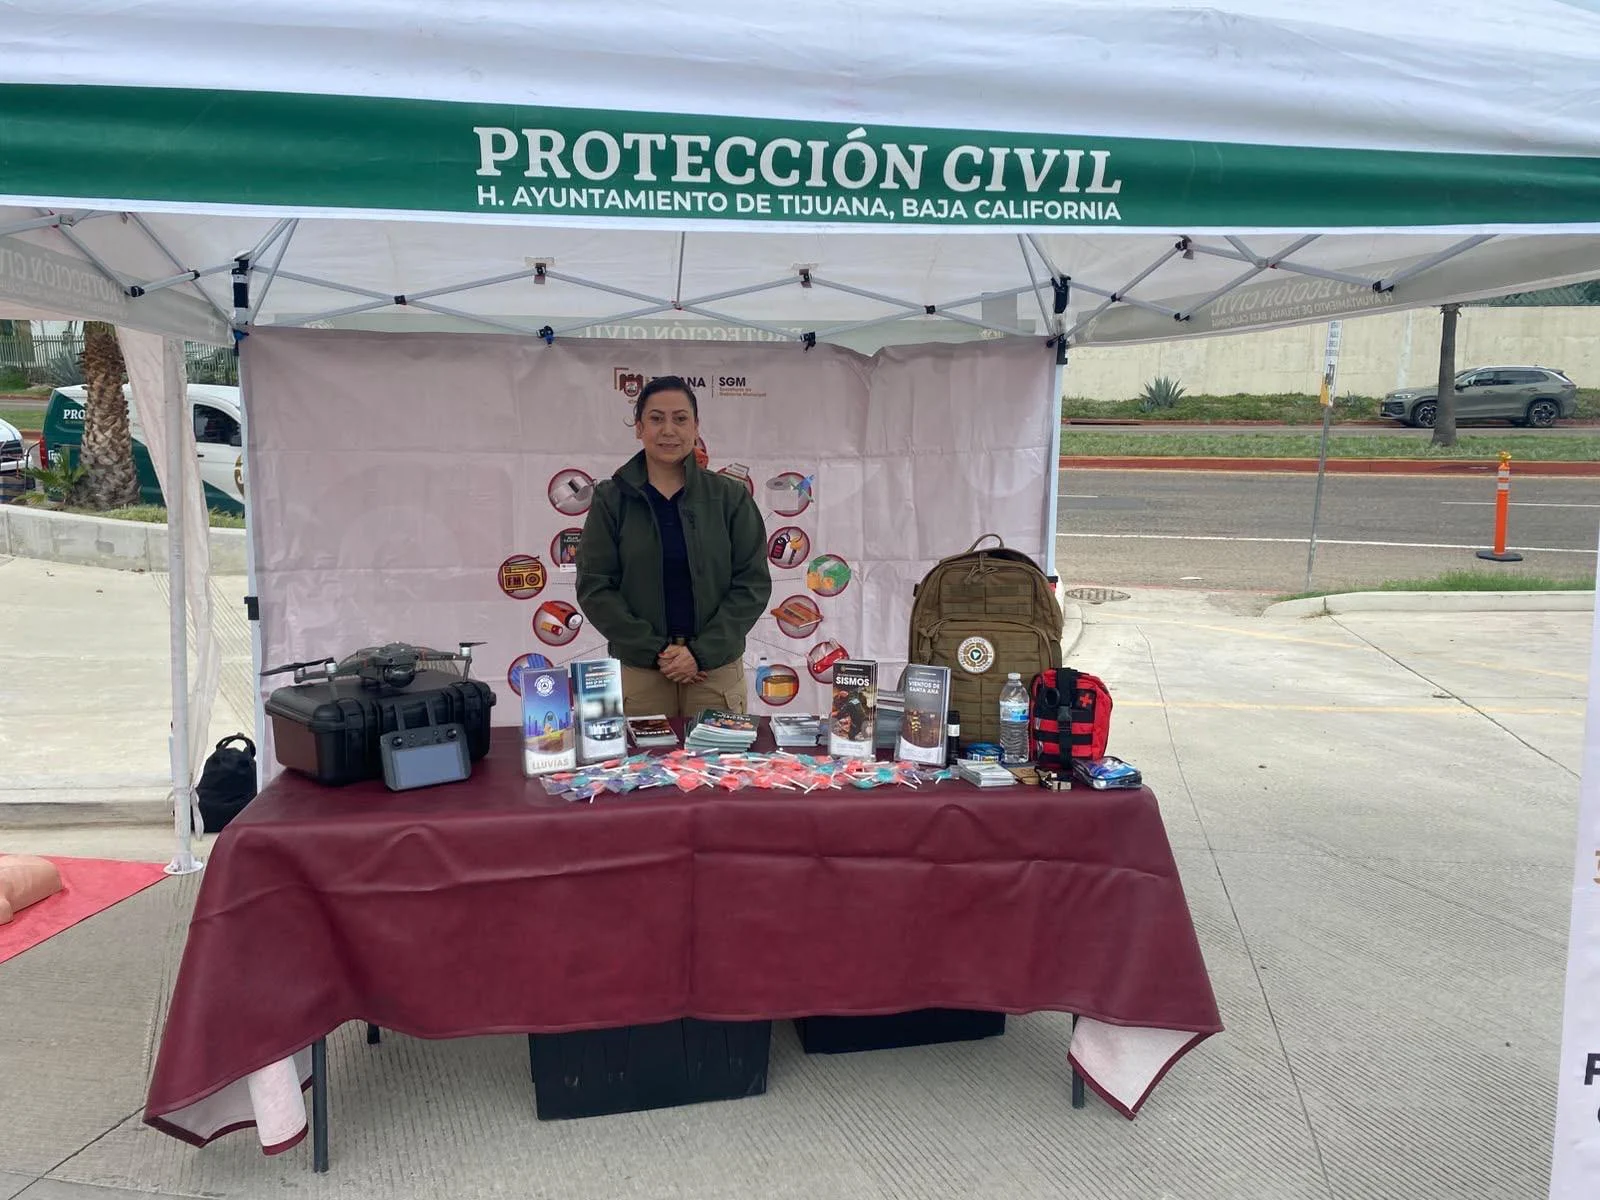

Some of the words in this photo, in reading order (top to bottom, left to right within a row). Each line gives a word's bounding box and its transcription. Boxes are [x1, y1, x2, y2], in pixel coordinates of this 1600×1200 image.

[473, 126, 929, 190] PROTECCIÓN
[943, 144, 1122, 194] CIVIL
[477, 185, 505, 206] H.
[511, 186, 728, 213] AYUNTAMIENTO
[735, 192, 772, 213] DE
[777, 194, 895, 221] TIJUANA,
[902, 197, 967, 218] BAJA
[974, 199, 1122, 220] CALIFORNIA
[719, 377, 746, 387] SGM
[835, 676, 870, 687] SISMOS
[532, 759, 569, 770] LLUVIAS
